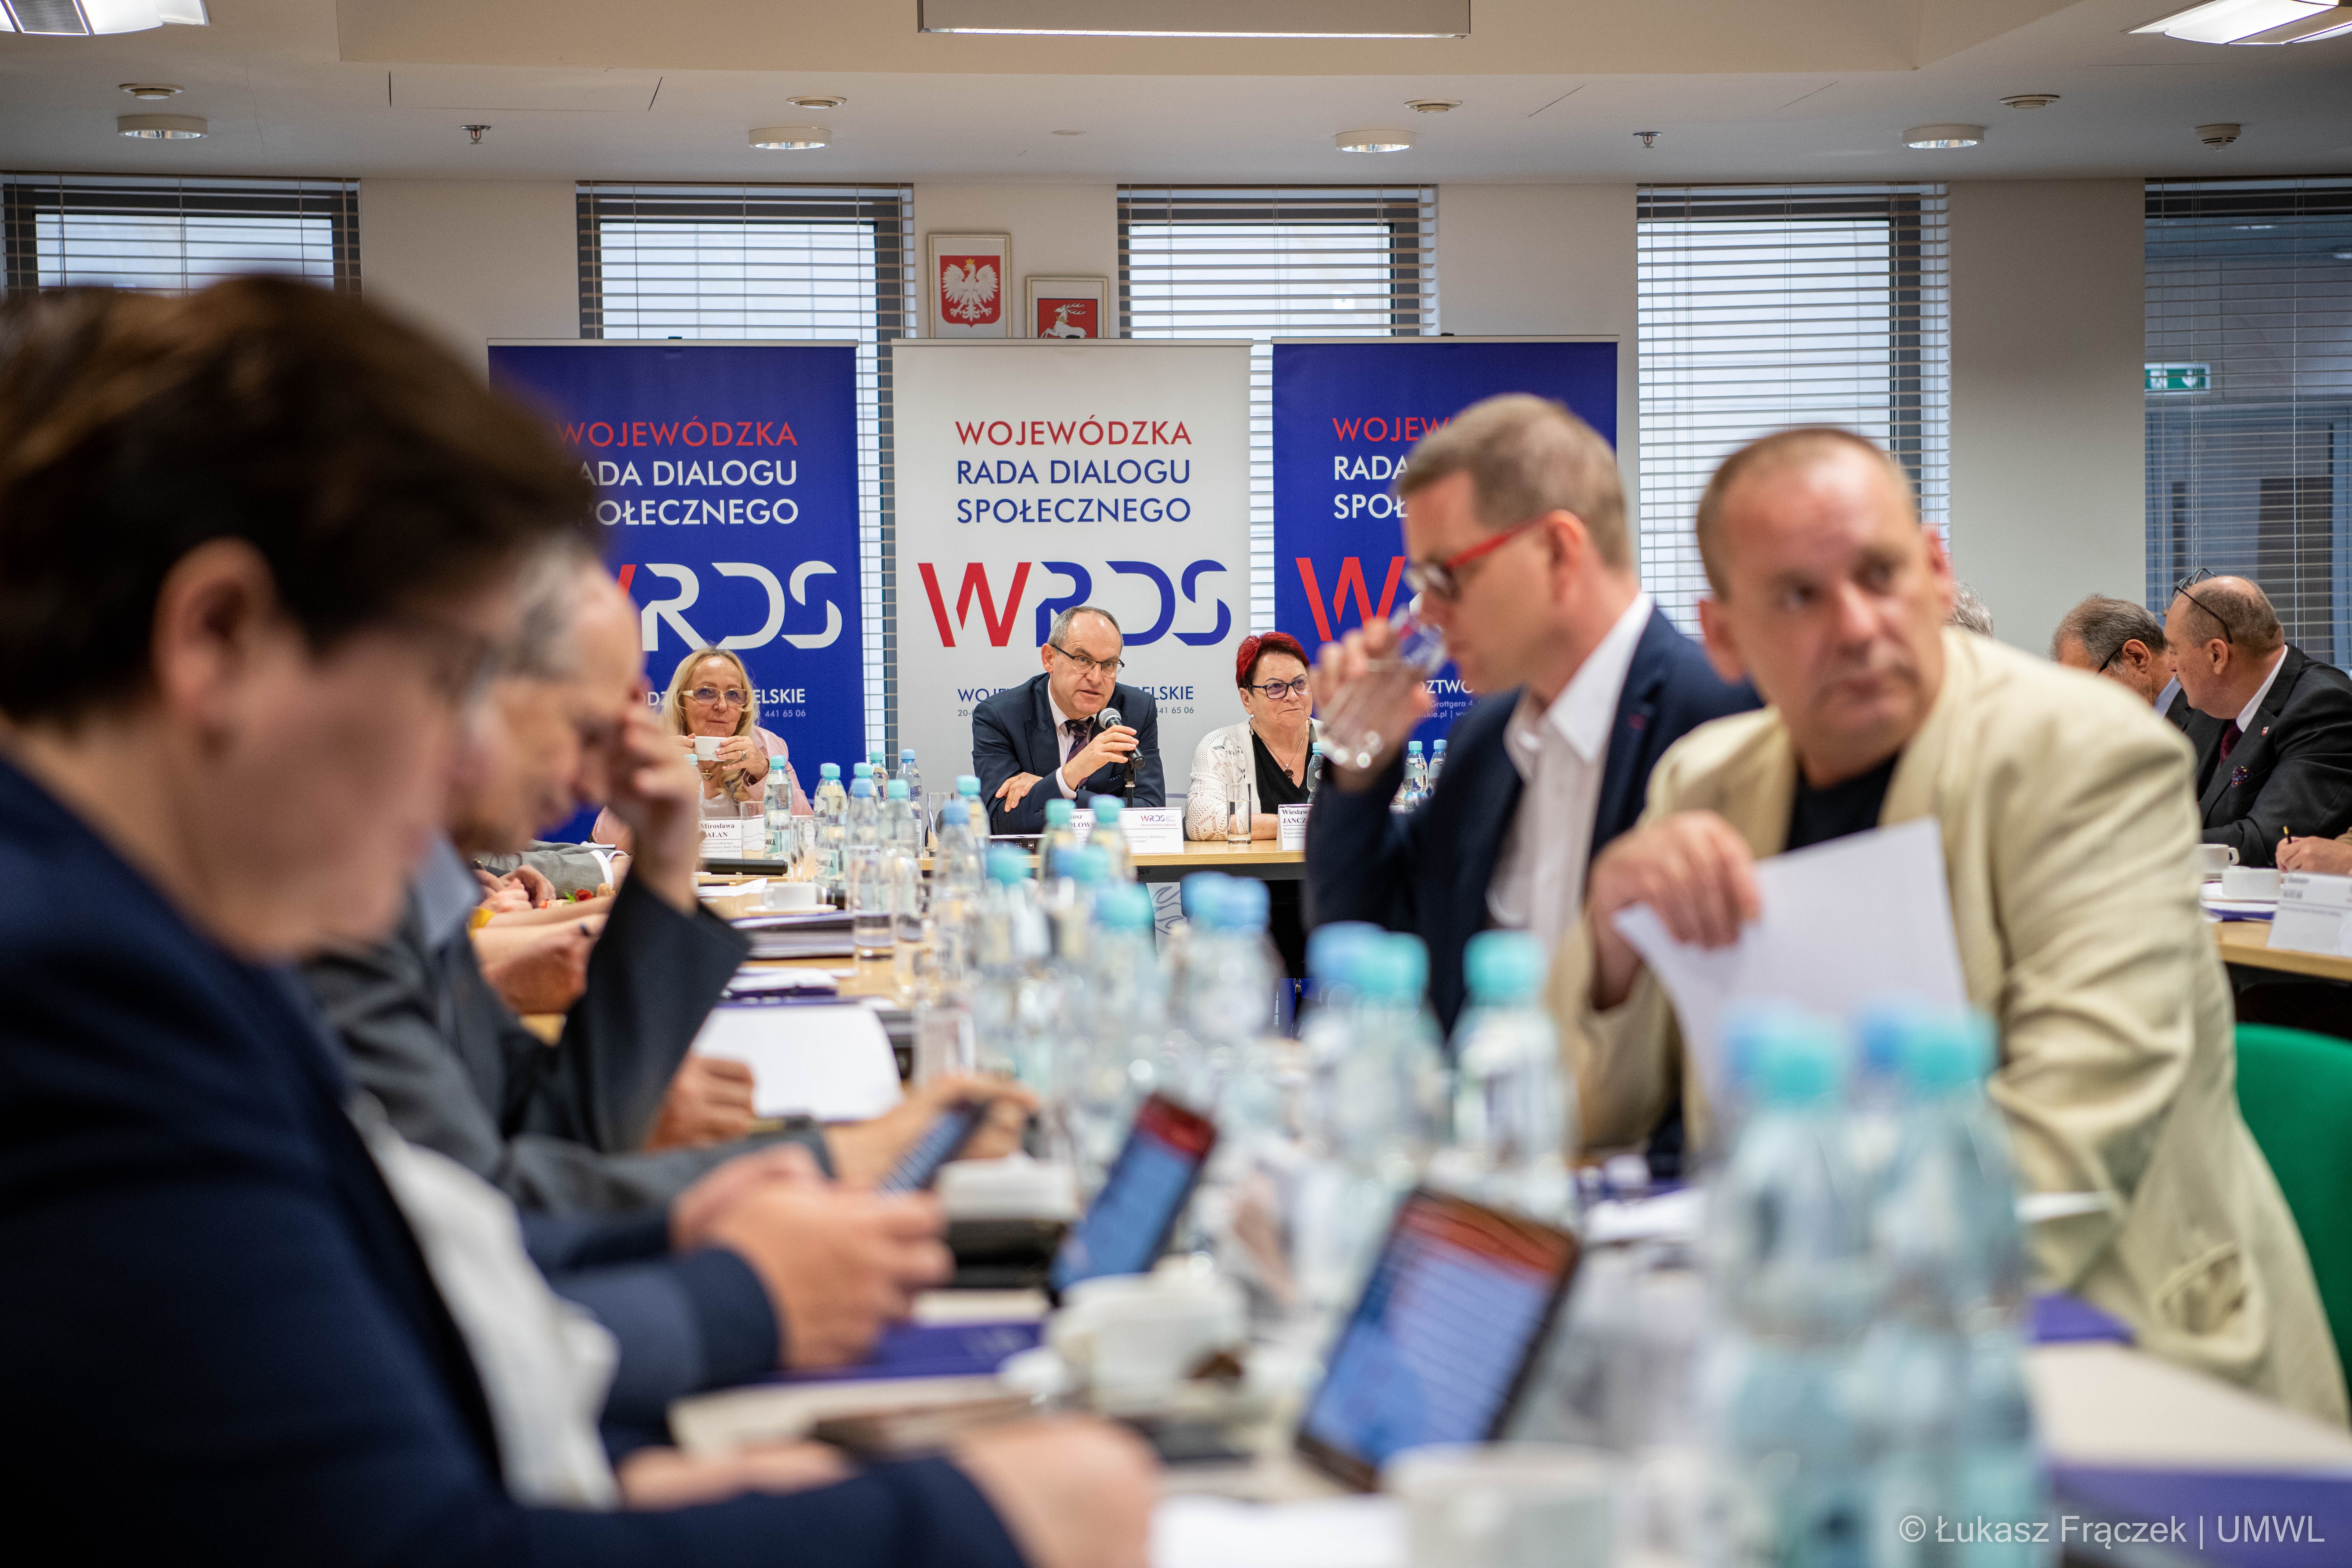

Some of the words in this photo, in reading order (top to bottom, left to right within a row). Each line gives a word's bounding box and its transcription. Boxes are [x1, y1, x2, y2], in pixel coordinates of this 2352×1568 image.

[555, 416, 798, 447] WOJEWÓDZKA
[955, 415, 1192, 446] WOJEWÓDZKA
[1332, 414, 1460, 442] WOJEW
[579, 460, 643, 486] ADA
[653, 460, 797, 486] DIALOGU
[957, 460, 1040, 484] RADA
[1051, 459, 1190, 484] DIALOGU
[1334, 455, 1408, 480] RADA
[595, 498, 799, 526] OŁECZNEGO
[957, 497, 1191, 523] SPOŁECZNEGO
[1334, 494, 1408, 519] SPOŁ
[618, 561, 842, 651] RDS
[917, 559, 1232, 648] WRDS
[753, 688, 806, 704] ELSKIE
